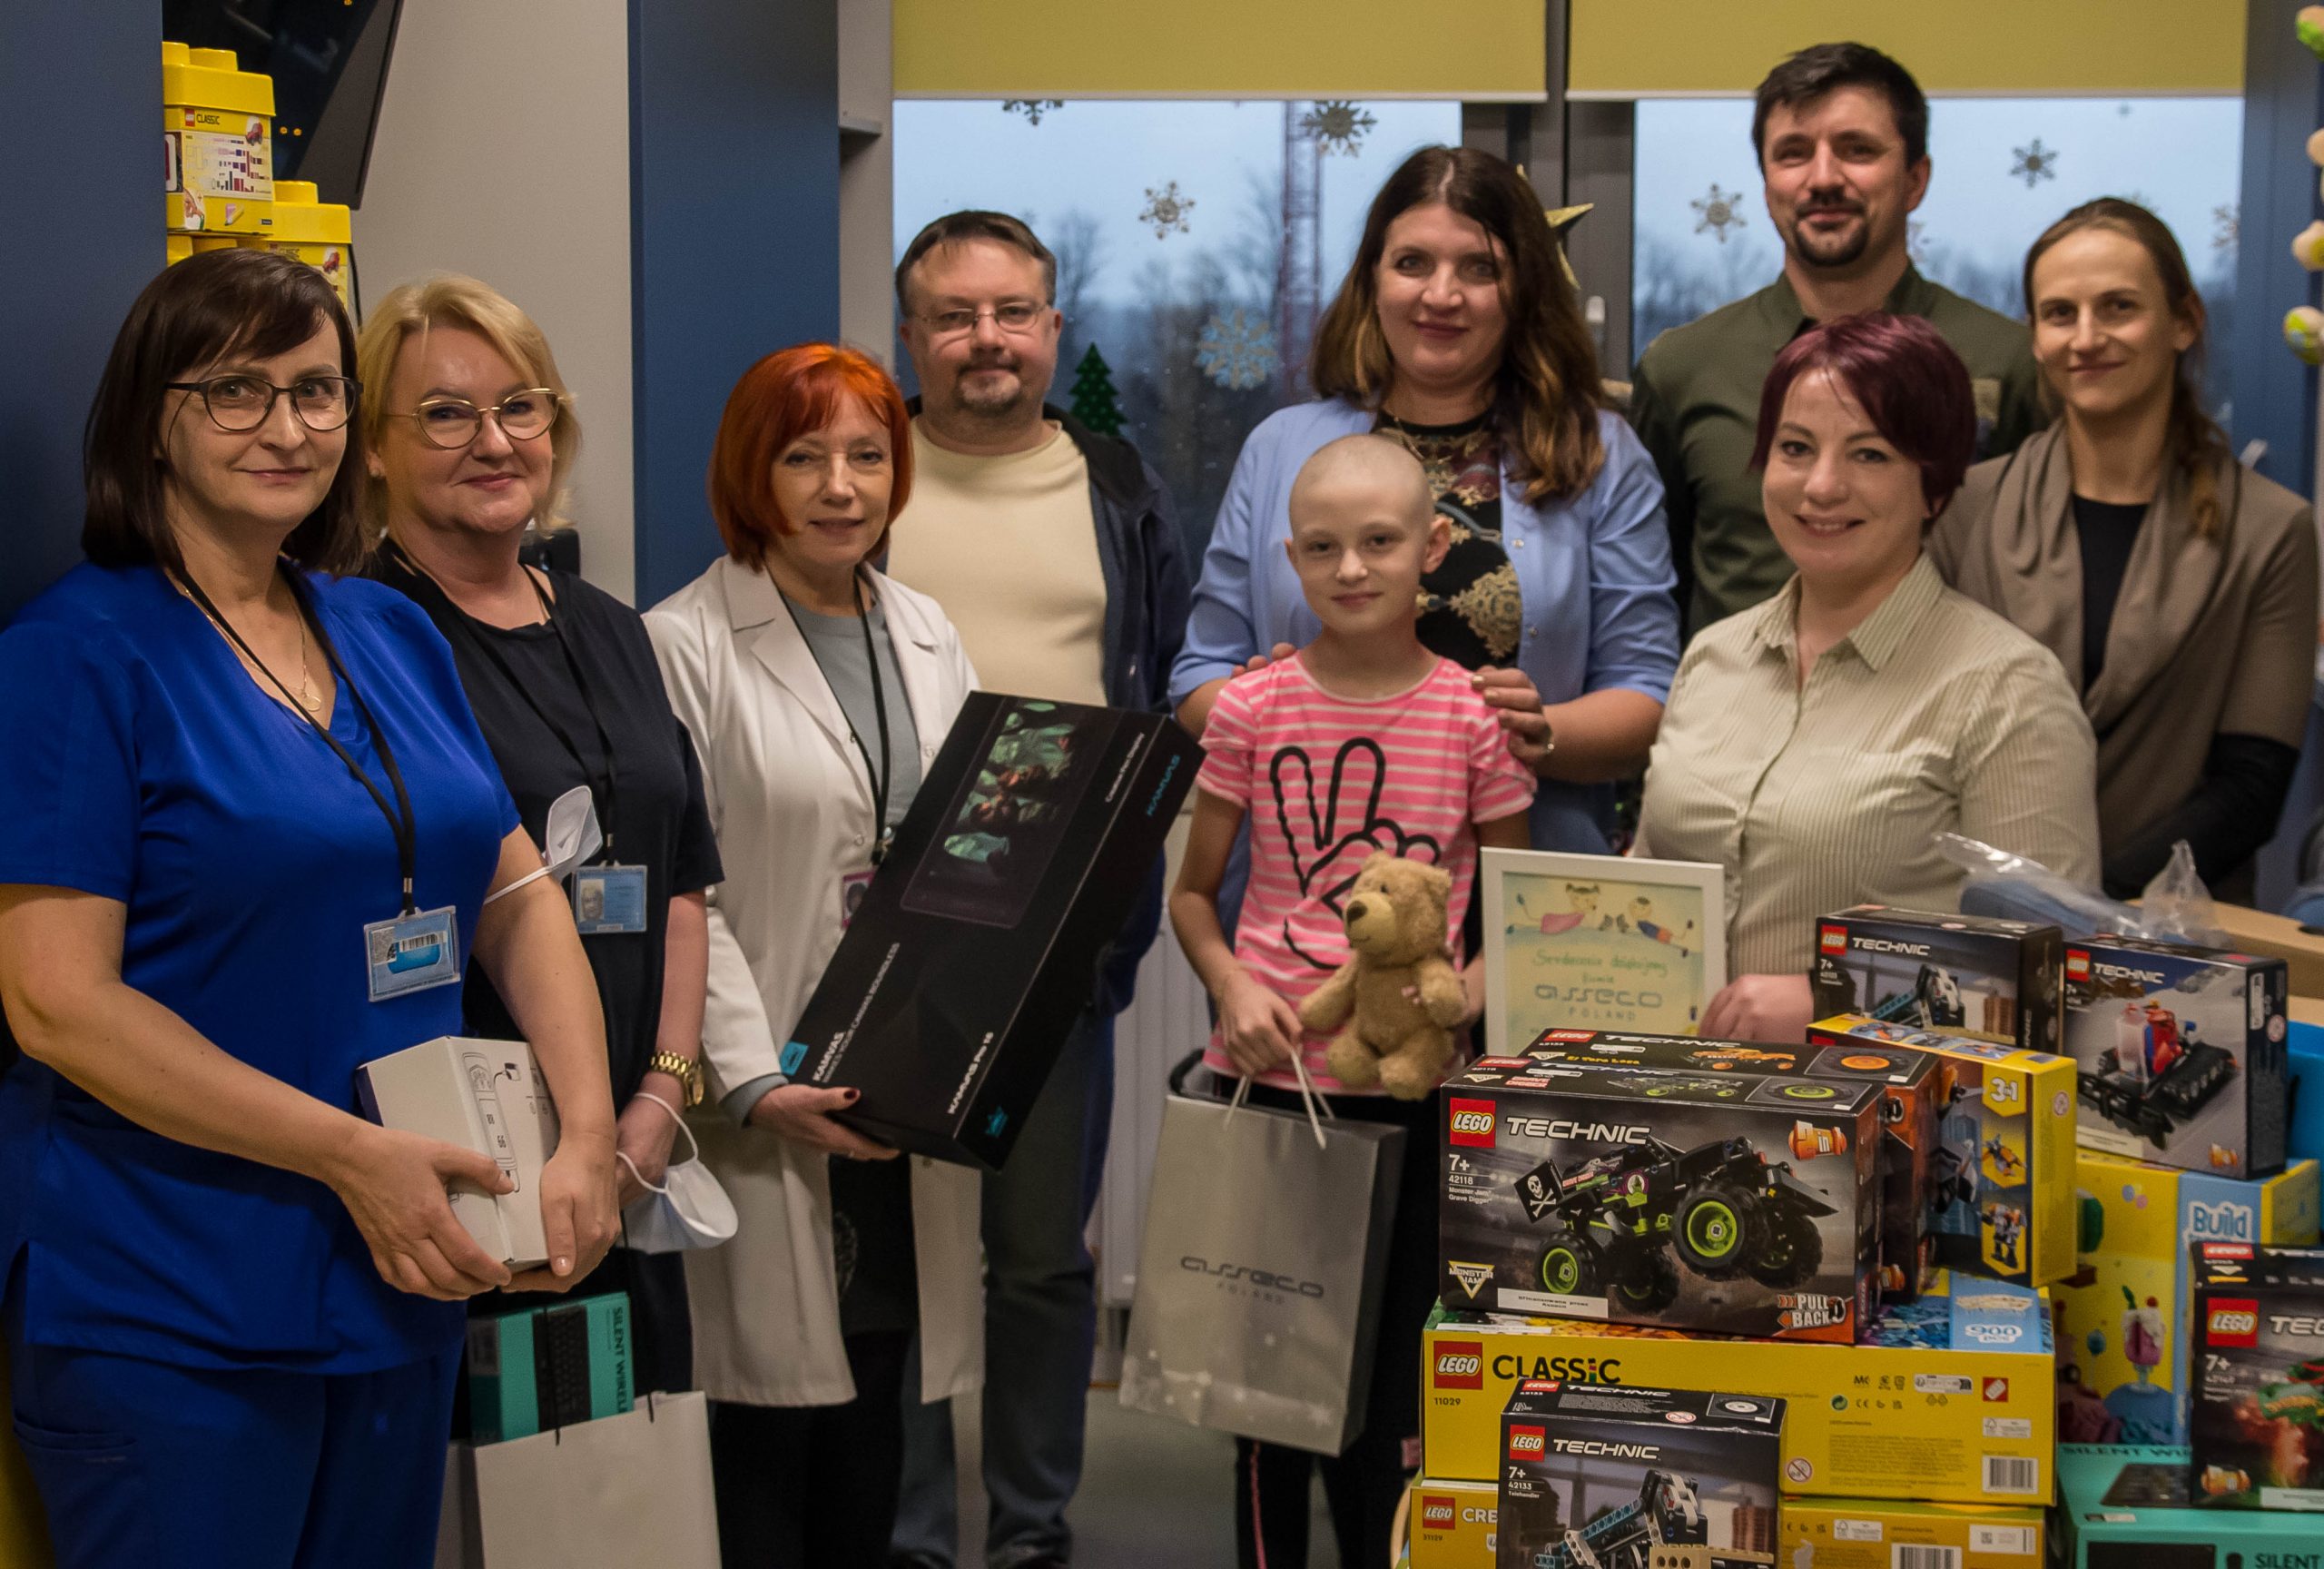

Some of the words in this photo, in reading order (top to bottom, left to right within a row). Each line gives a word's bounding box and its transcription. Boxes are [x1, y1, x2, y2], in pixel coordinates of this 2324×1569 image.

[197, 113, 220, 124] CLASSIC
[1824, 933, 1846, 945] LEGO
[1853, 937, 1931, 955] TECHNIC
[1820, 959, 1833, 969] 7+
[2093, 962, 2165, 984] TECHNIC
[1535, 984, 1663, 1008] asseco
[1605, 1034, 1740, 1047] TECHNIC
[1541, 1061, 1679, 1076] TECHNIC
[1453, 1113, 1493, 1132] LEGO
[1506, 1117, 1650, 1145] TECHNIC
[1449, 1154, 1470, 1171] 7+
[1449, 1175, 1473, 1185] 42118
[1449, 1193, 1467, 1201] Grave
[2193, 1205, 2248, 1238] Build
[1449, 1268, 1494, 1279] MONSTER
[1796, 1294, 1829, 1310] PULL
[1793, 1311, 1830, 1327] BACK
[2211, 1313, 2255, 1332] LEGO
[613, 1307, 624, 1357] SILENT
[1967, 1325, 2018, 1337] 900
[1438, 1357, 1480, 1374] LEGO
[1492, 1354, 1621, 1384] CLASSIC
[2205, 1354, 2230, 1371] 7+
[1567, 1385, 1670, 1397] TECHNIC
[1434, 1397, 1461, 1406] 11029
[1512, 1436, 1542, 1450] LEGO
[1553, 1439, 1660, 1460] TECHNIC
[1509, 1466, 1526, 1479] 7+
[1508, 1481, 1532, 1491] 42133
[1425, 1506, 1452, 1519] LEGO
[2255, 1553, 2320, 1569] SILENT
